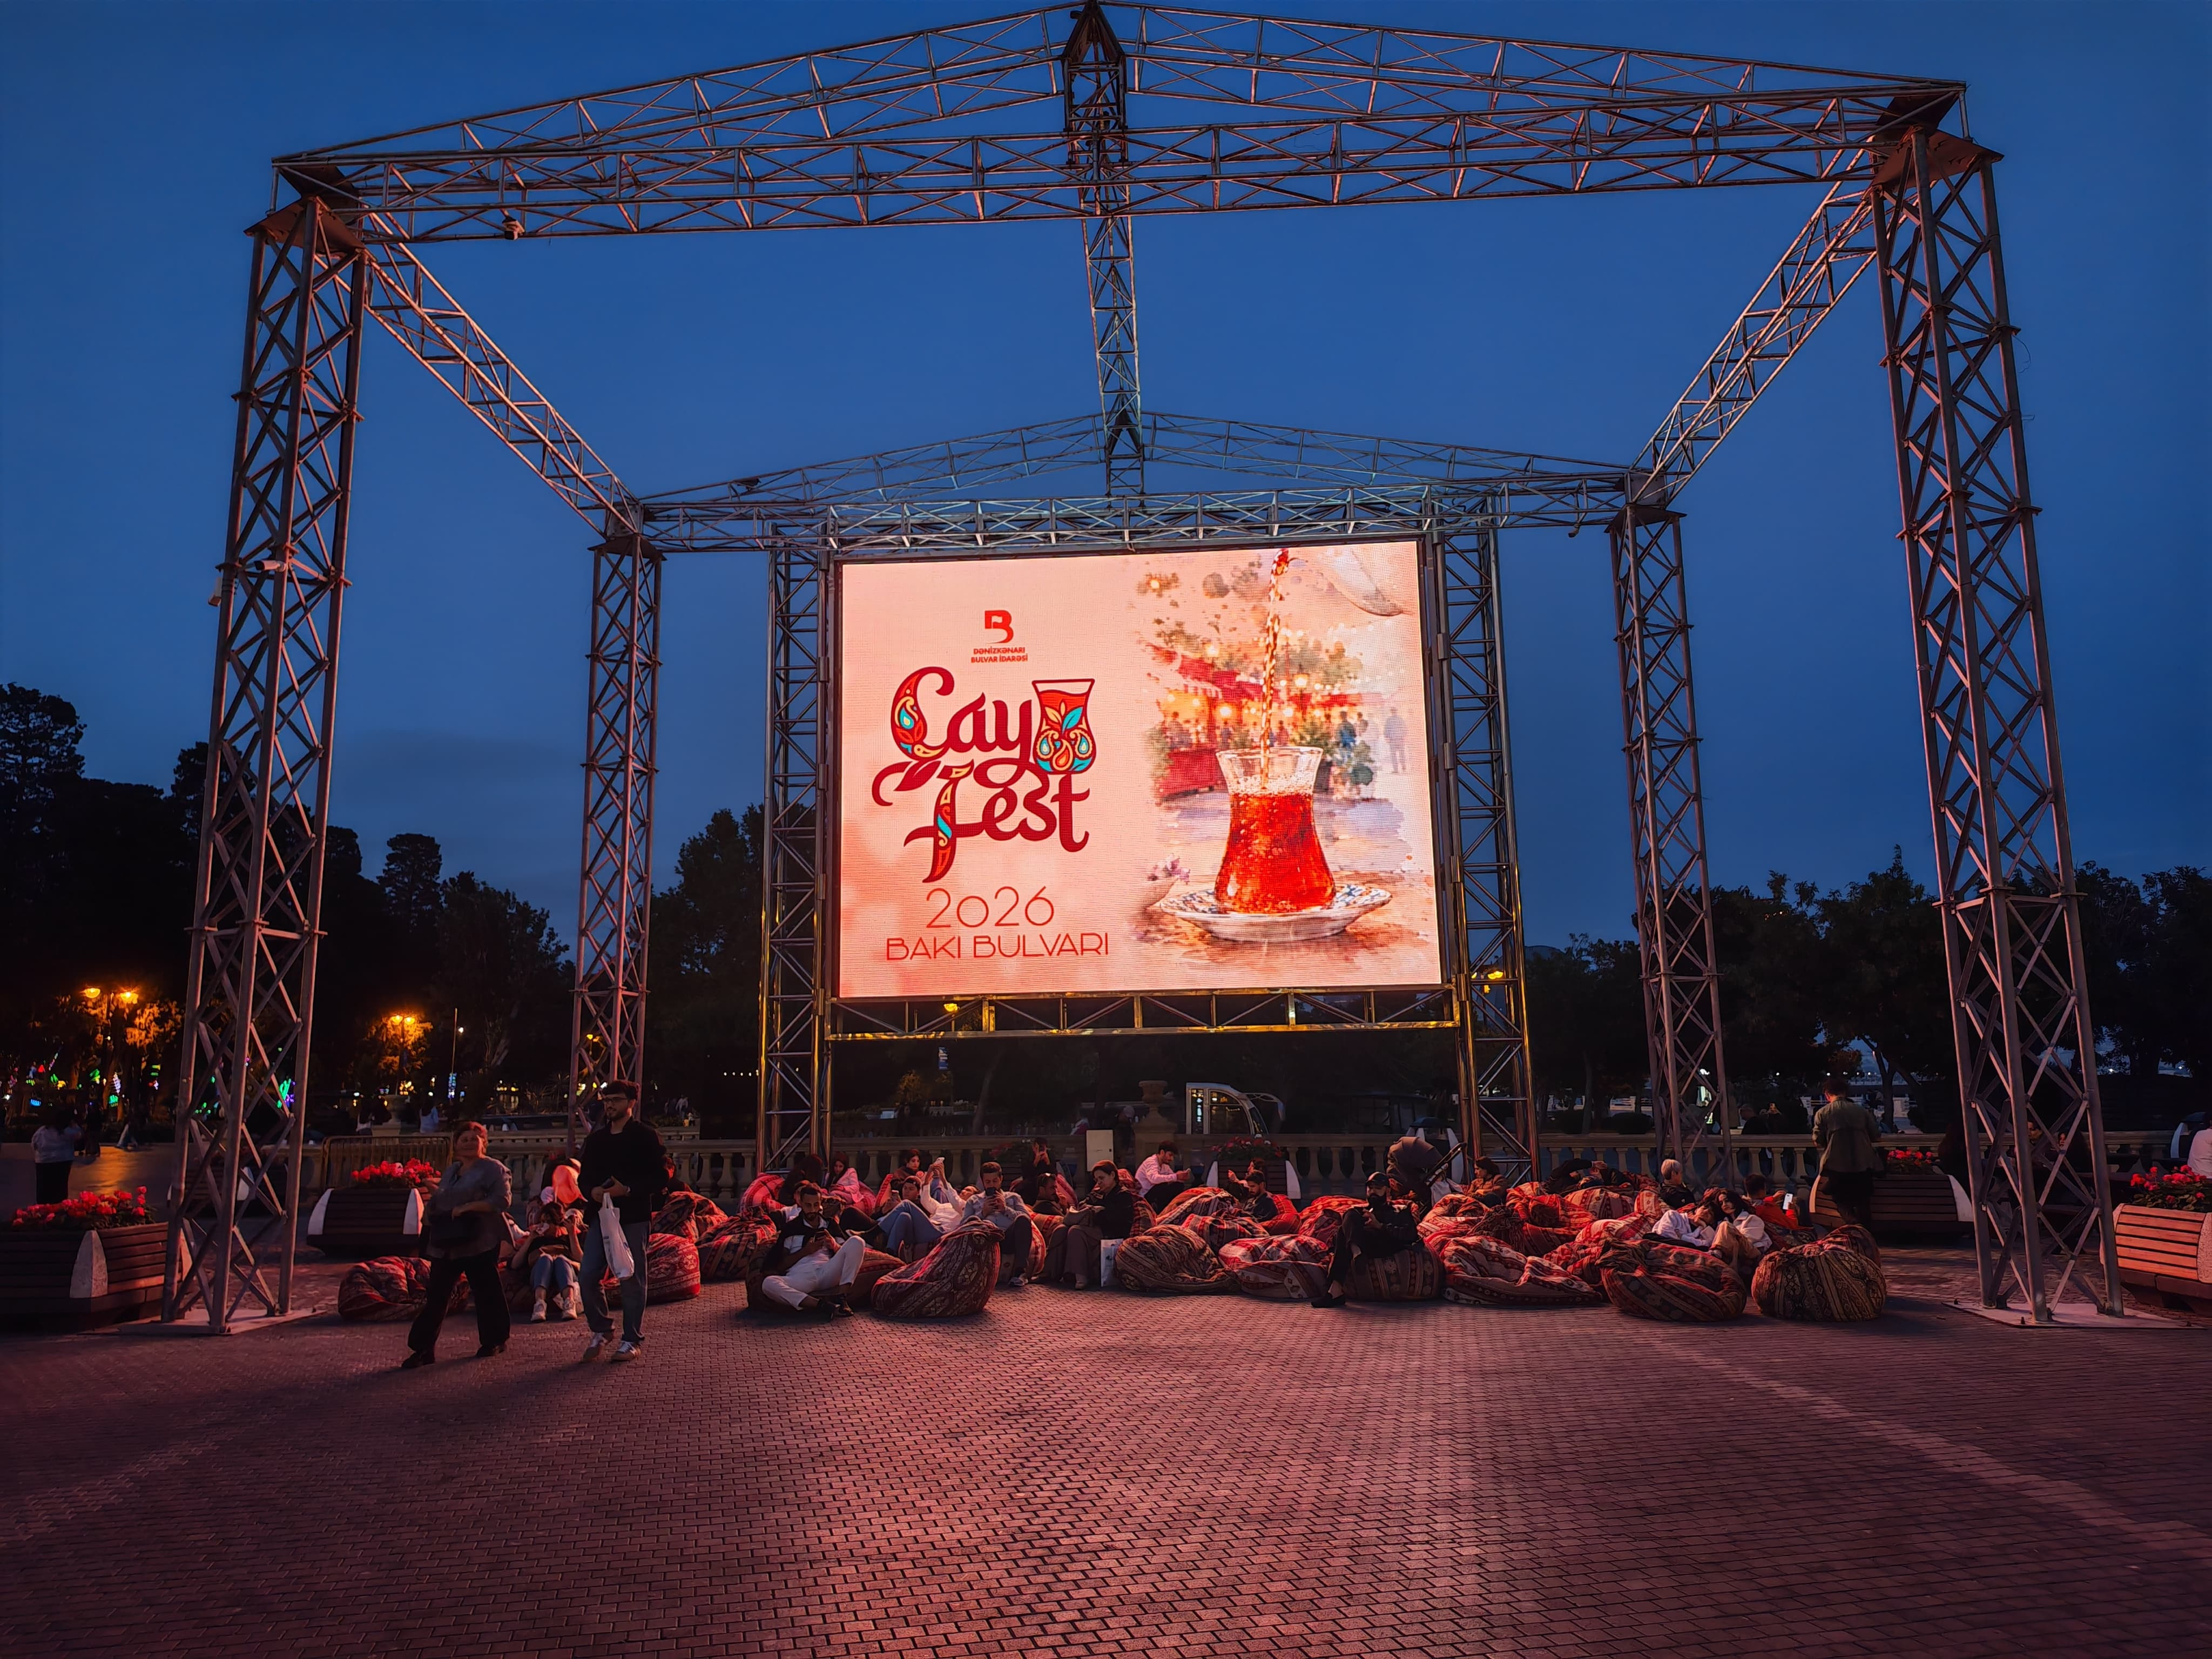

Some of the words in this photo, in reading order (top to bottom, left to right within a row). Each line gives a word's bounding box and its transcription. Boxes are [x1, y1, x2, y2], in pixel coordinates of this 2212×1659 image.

[973, 646, 1026, 655] DƏNİZKƏNARI
[999, 653, 1028, 663] İDARƏSİ
[926, 886, 1055, 928] 2026
[886, 936, 961, 961] BAKI
[973, 932, 1109, 958] BULVARI
